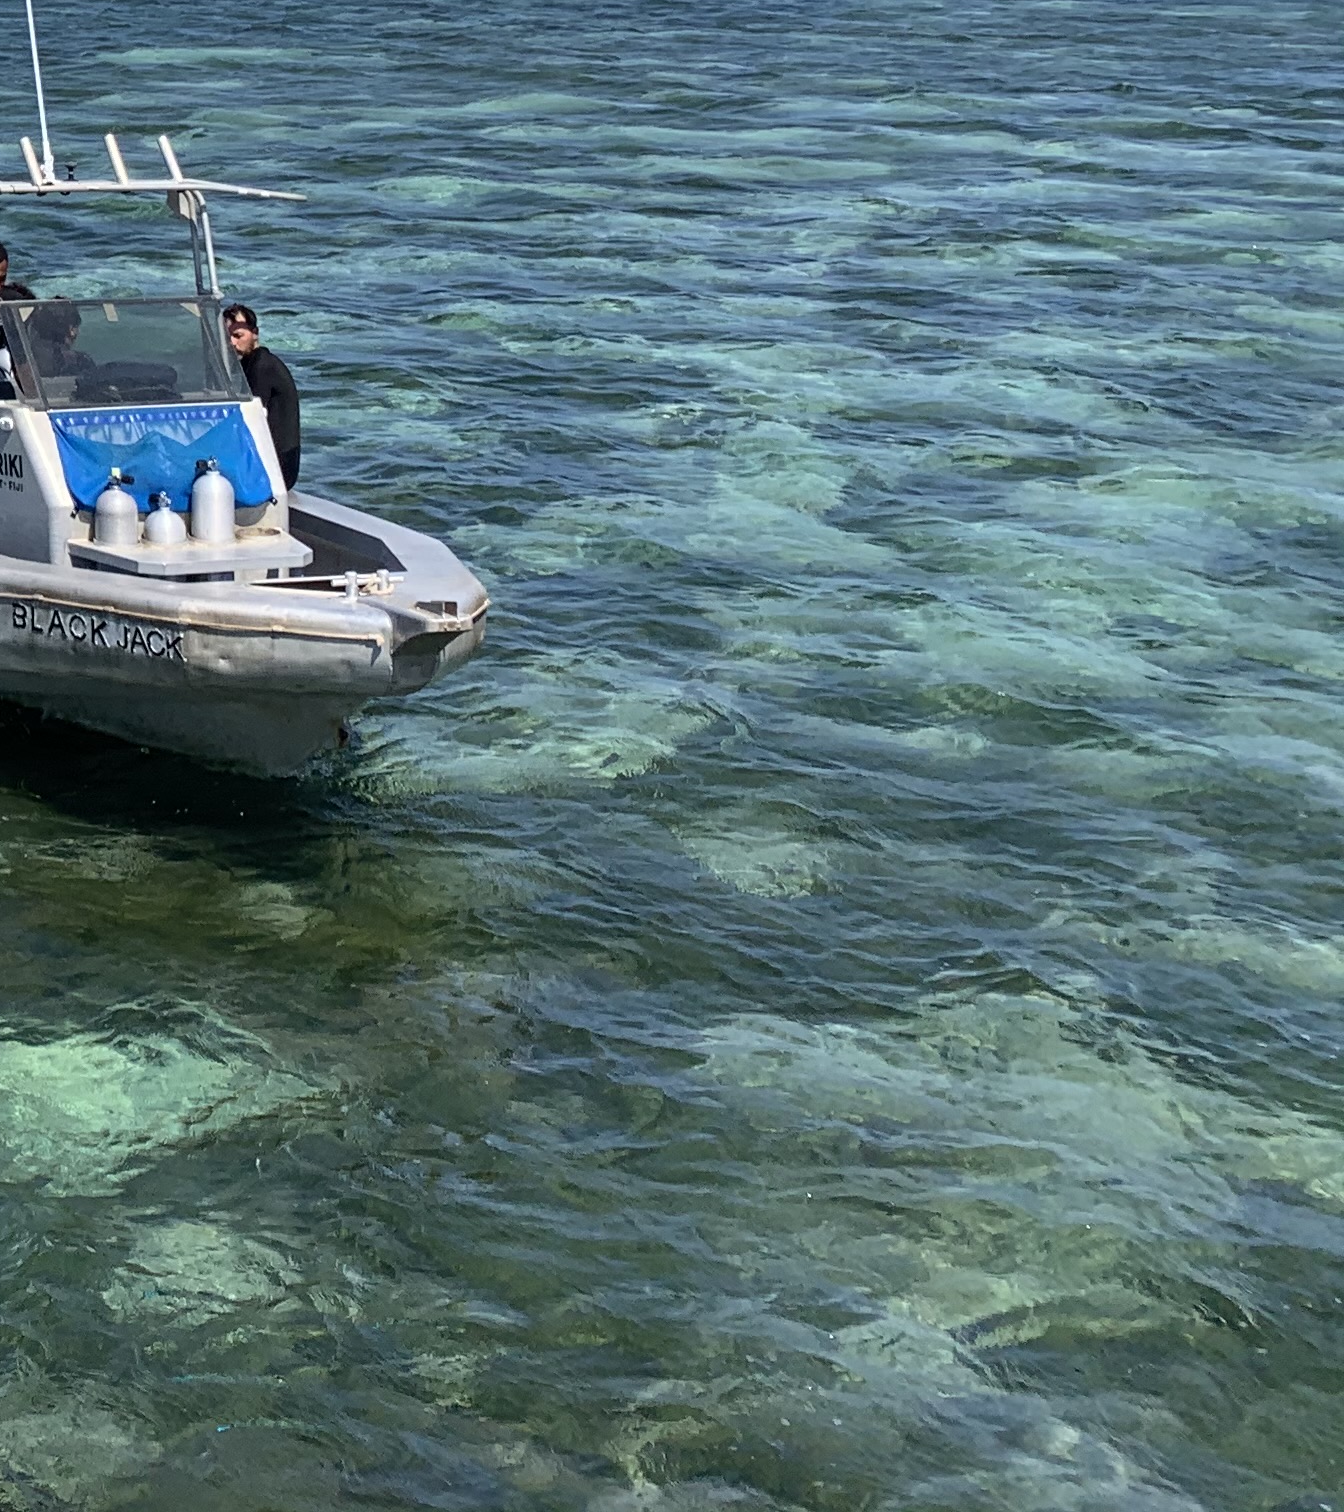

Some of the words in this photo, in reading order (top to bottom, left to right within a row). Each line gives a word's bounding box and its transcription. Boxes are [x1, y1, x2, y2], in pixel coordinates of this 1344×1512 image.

[8, 480, 24, 492] FIJI
[12, 602, 111, 648] BLACK
[116, 623, 188, 663] JACK
